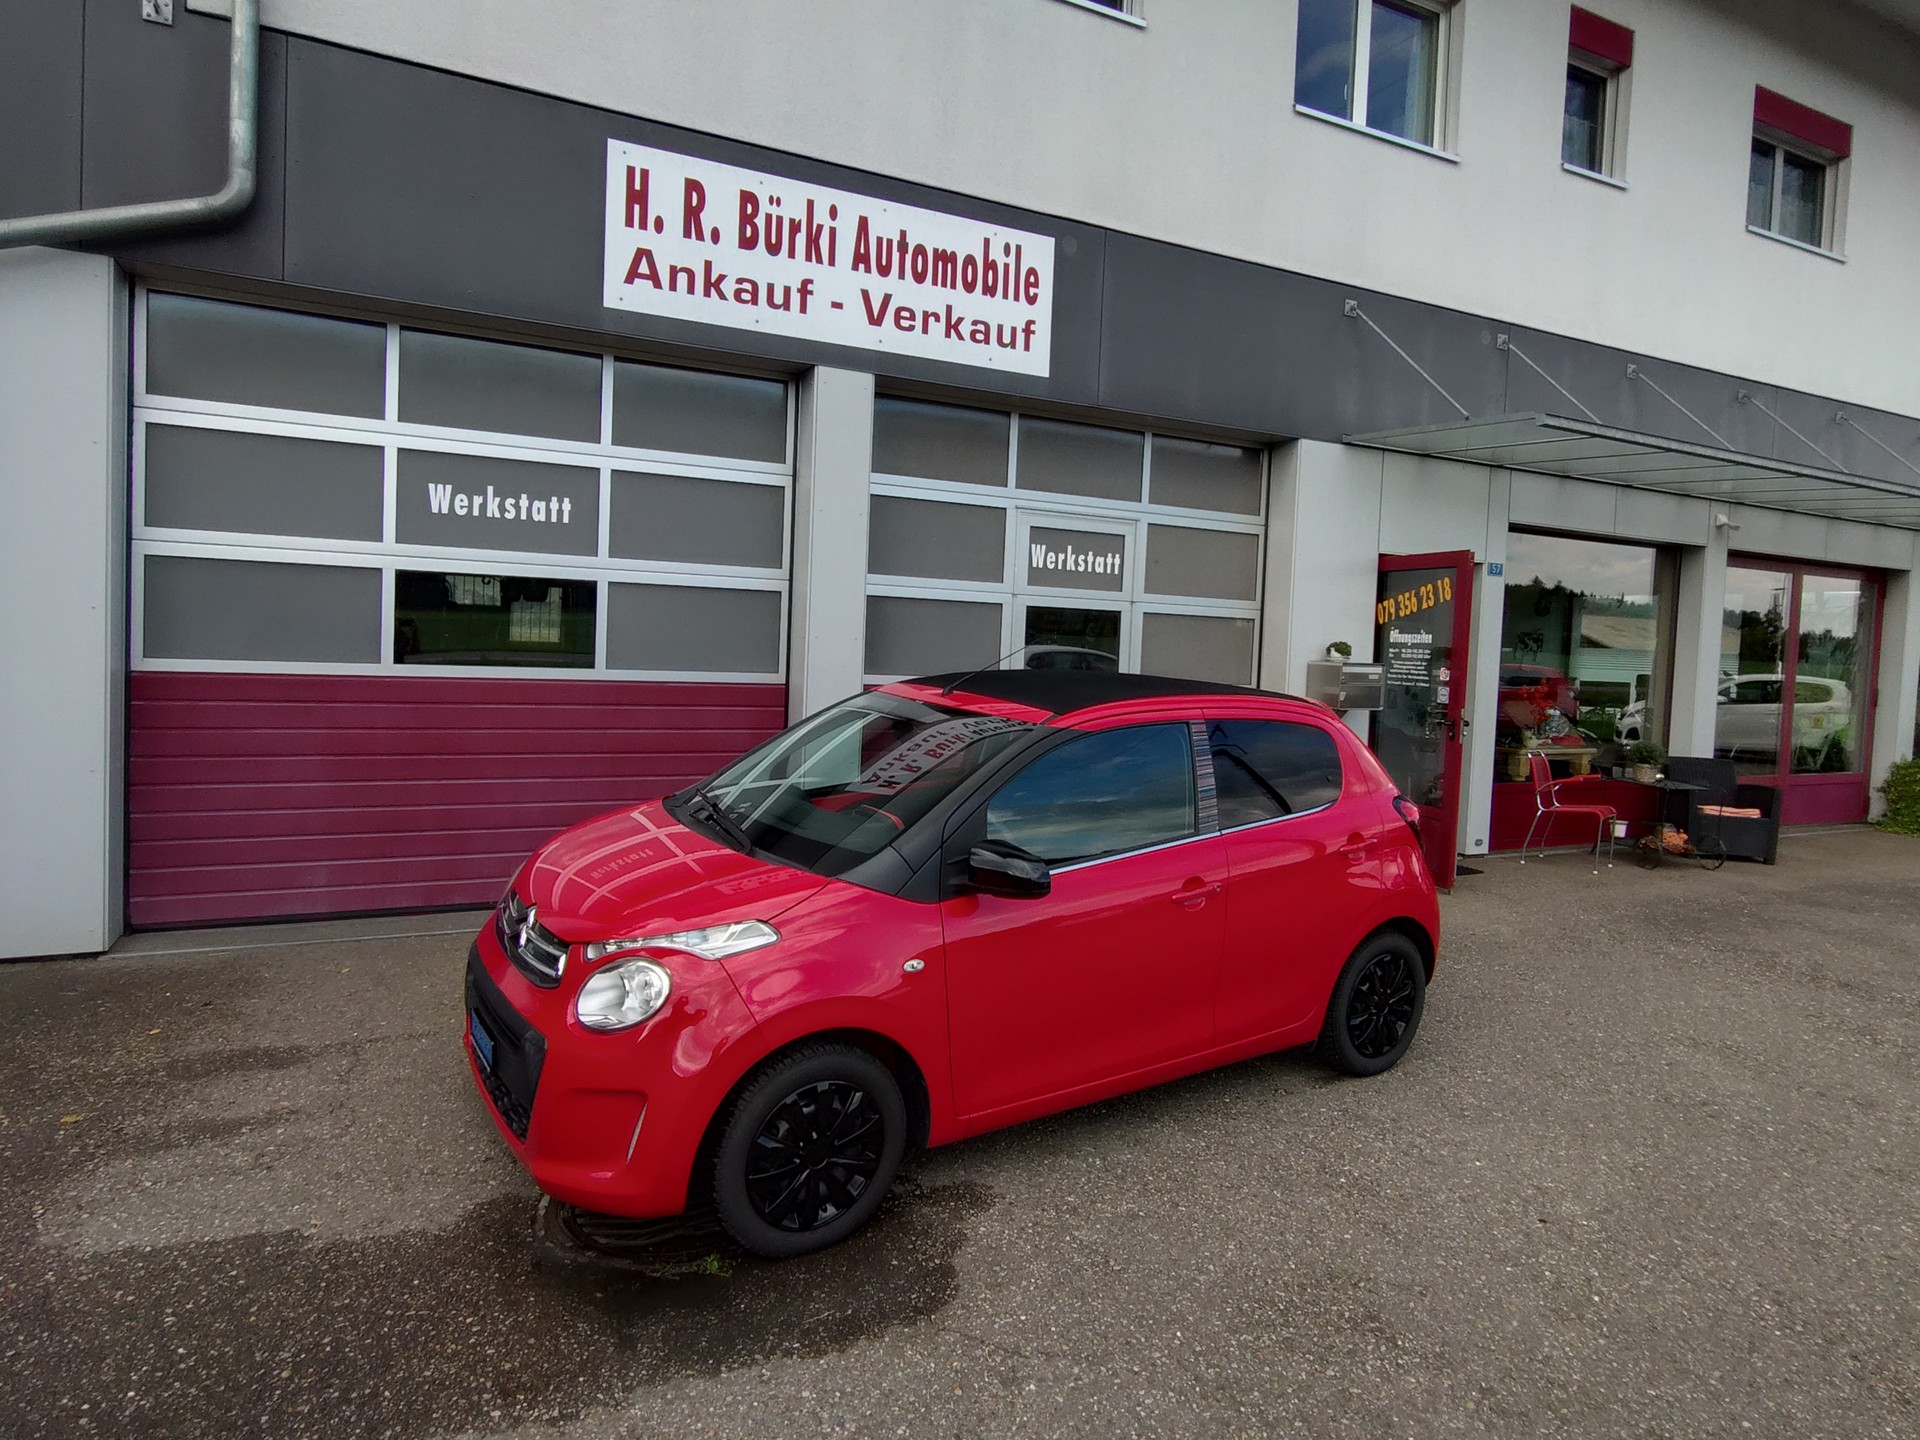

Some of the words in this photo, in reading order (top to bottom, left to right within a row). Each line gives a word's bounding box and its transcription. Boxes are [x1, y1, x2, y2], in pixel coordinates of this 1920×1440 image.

[624, 164, 665, 235] H.
[682, 176, 721, 246] R.
[737, 188, 838, 268] Bürki
[851, 214, 1040, 306] Automobile
[623, 246, 814, 315] Ankauf
[860, 288, 1037, 352] Verkauf
[428, 483, 571, 524] Werkstatt
[1031, 543, 1121, 575] Werkstatt
[1377, 598, 1396, 625] 079
[1398, 589, 1418, 617] 356
[1420, 583, 1435, 610] 23
[1437, 576, 1452, 603] 18
